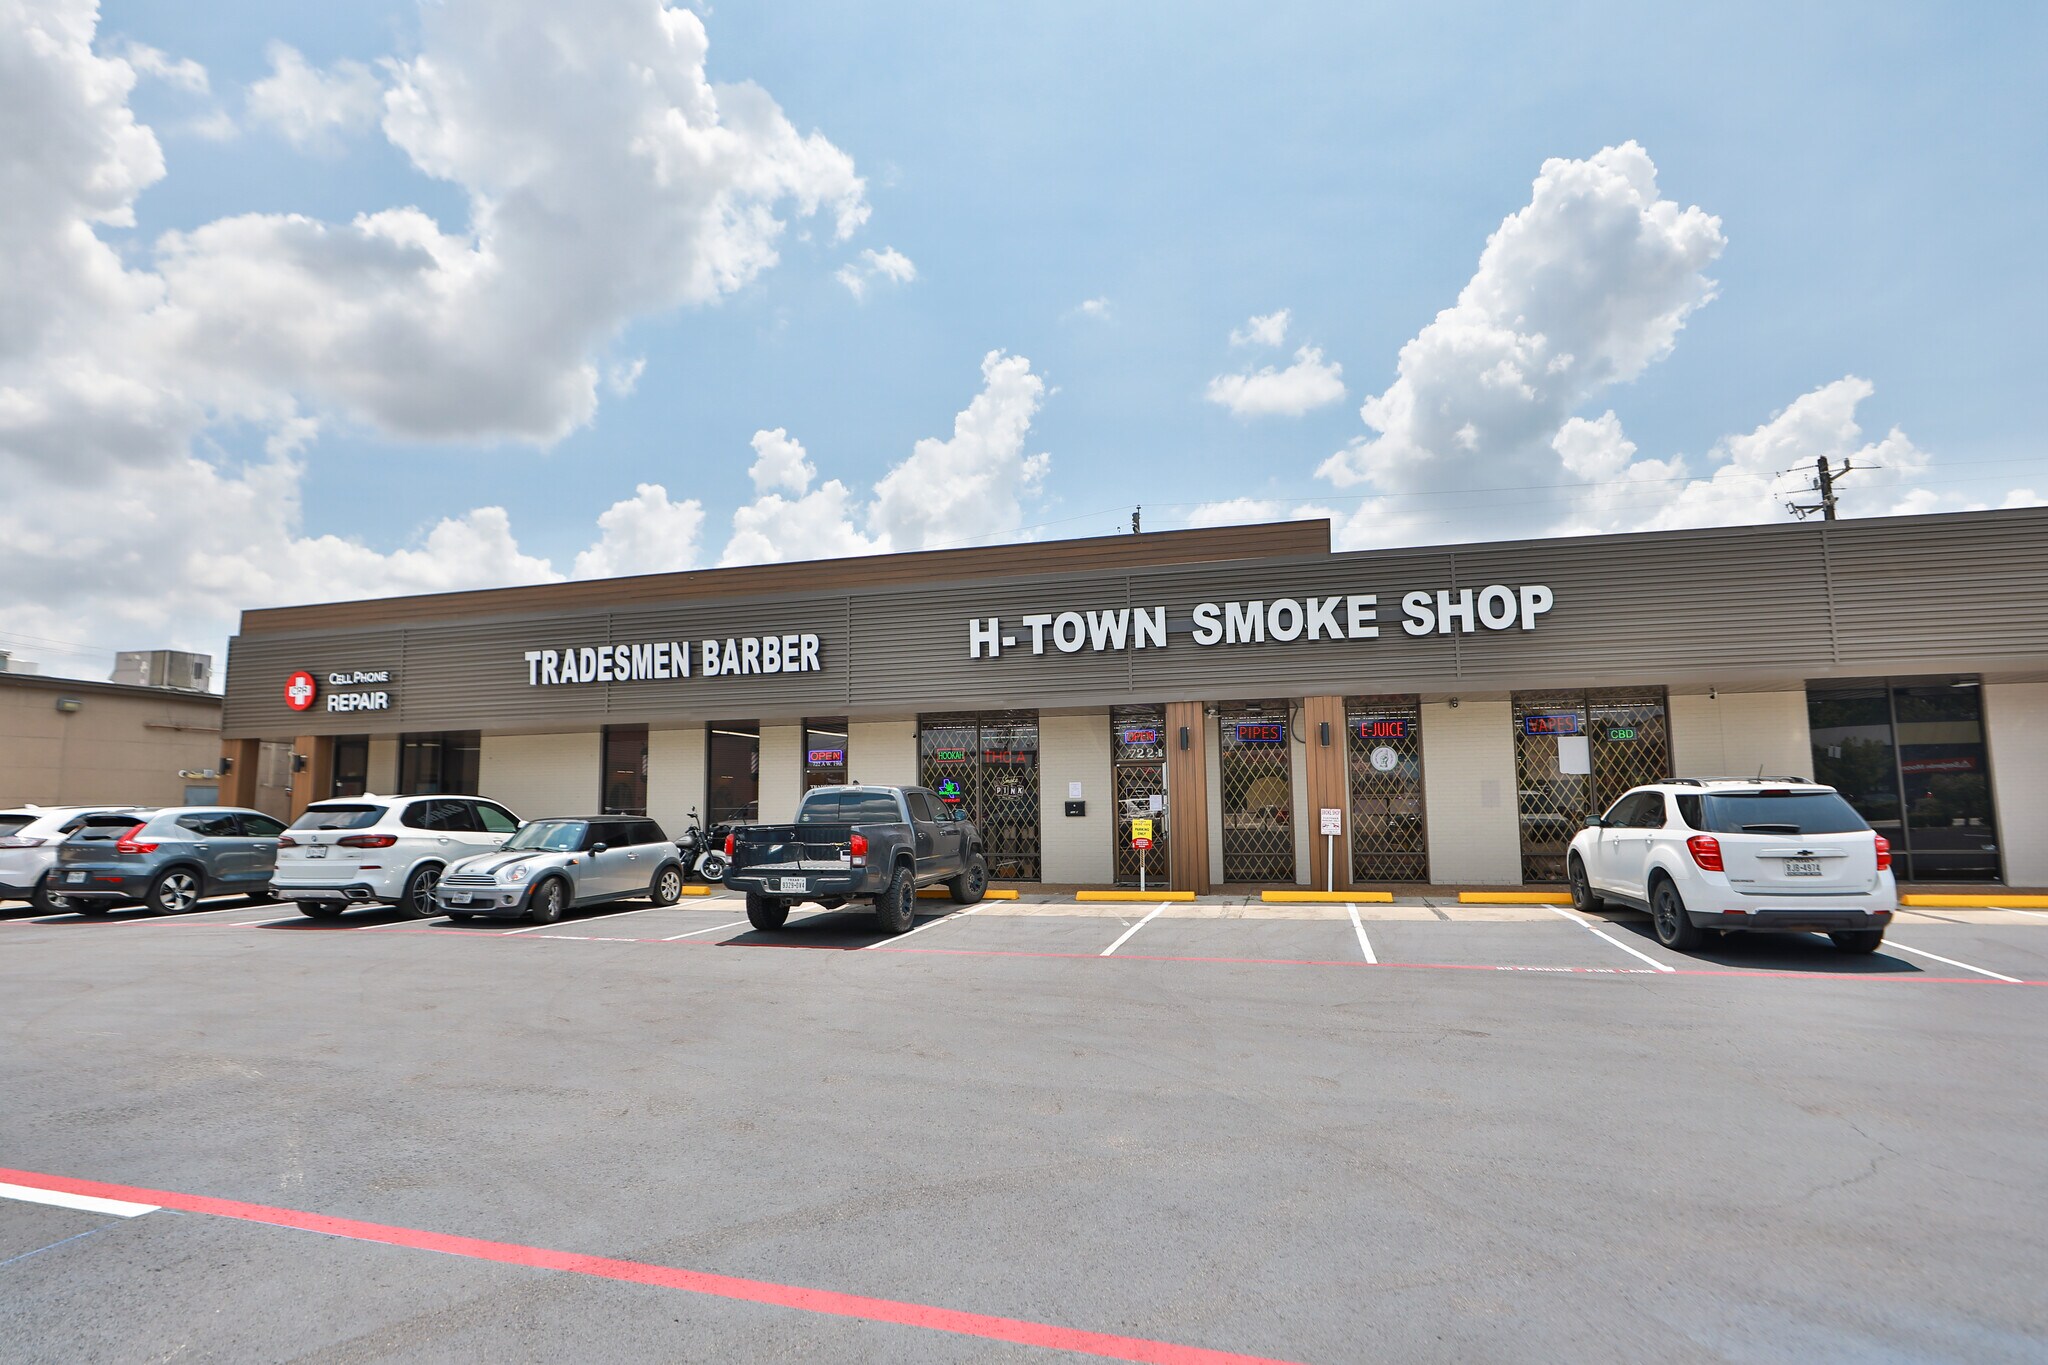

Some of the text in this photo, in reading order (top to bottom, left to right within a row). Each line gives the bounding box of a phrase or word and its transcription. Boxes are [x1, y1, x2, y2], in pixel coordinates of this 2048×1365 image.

[969, 584, 1554, 658] H-TOWN SMOKE SHOP
[524, 633, 821, 686] TRADESMEN BARBER
[327, 692, 389, 712] REPAIR
[1361, 722, 1404, 737] E-JUICE
[1529, 716, 1574, 732] VAPES
[1127, 731, 1154, 742] OPEN
[1240, 726, 1279, 739] PIPES
[1610, 729, 1634, 739] CBD
[811, 751, 841, 761] OPEN
[938, 751, 964, 760] HOOKAH
